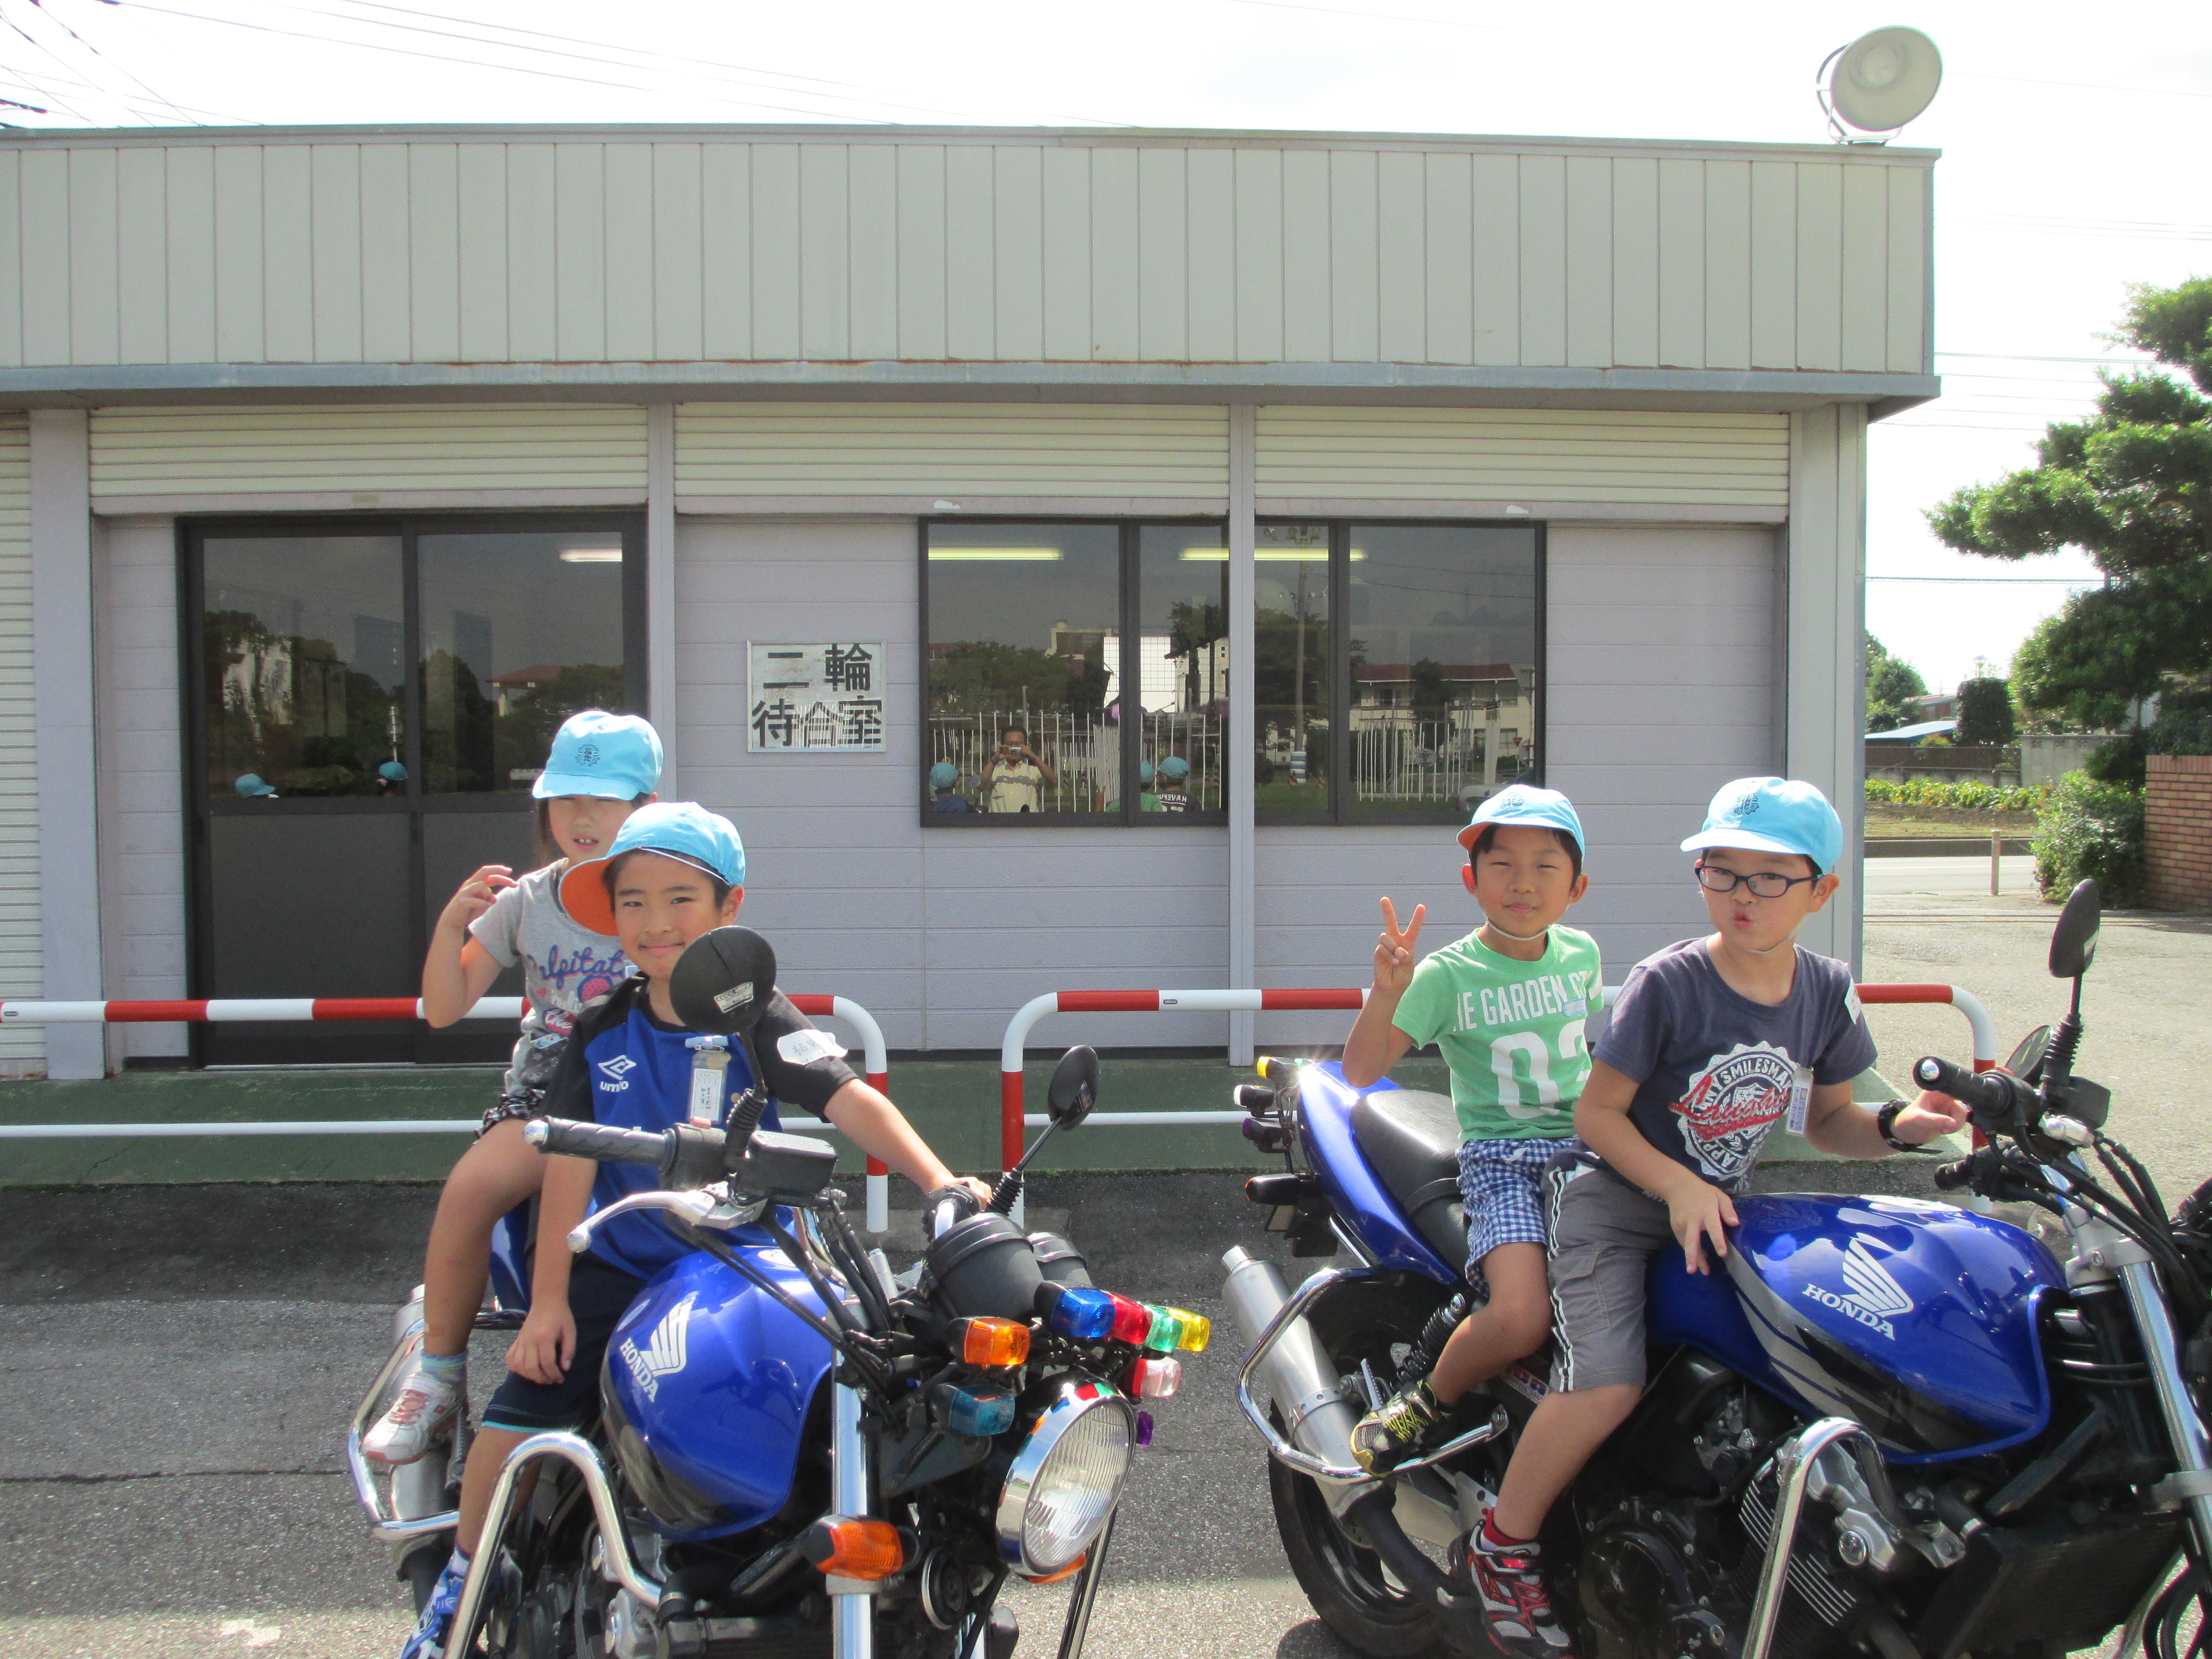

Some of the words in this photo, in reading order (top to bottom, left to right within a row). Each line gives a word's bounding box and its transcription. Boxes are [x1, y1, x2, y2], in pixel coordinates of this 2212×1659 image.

[763, 643, 872, 692] 二輪
[752, 696, 882, 747] 待合室
[1480, 975, 1568, 1026] GARDEN
[1802, 1283, 1896, 1341] HONDA
[619, 1337, 659, 1403] HONDA
